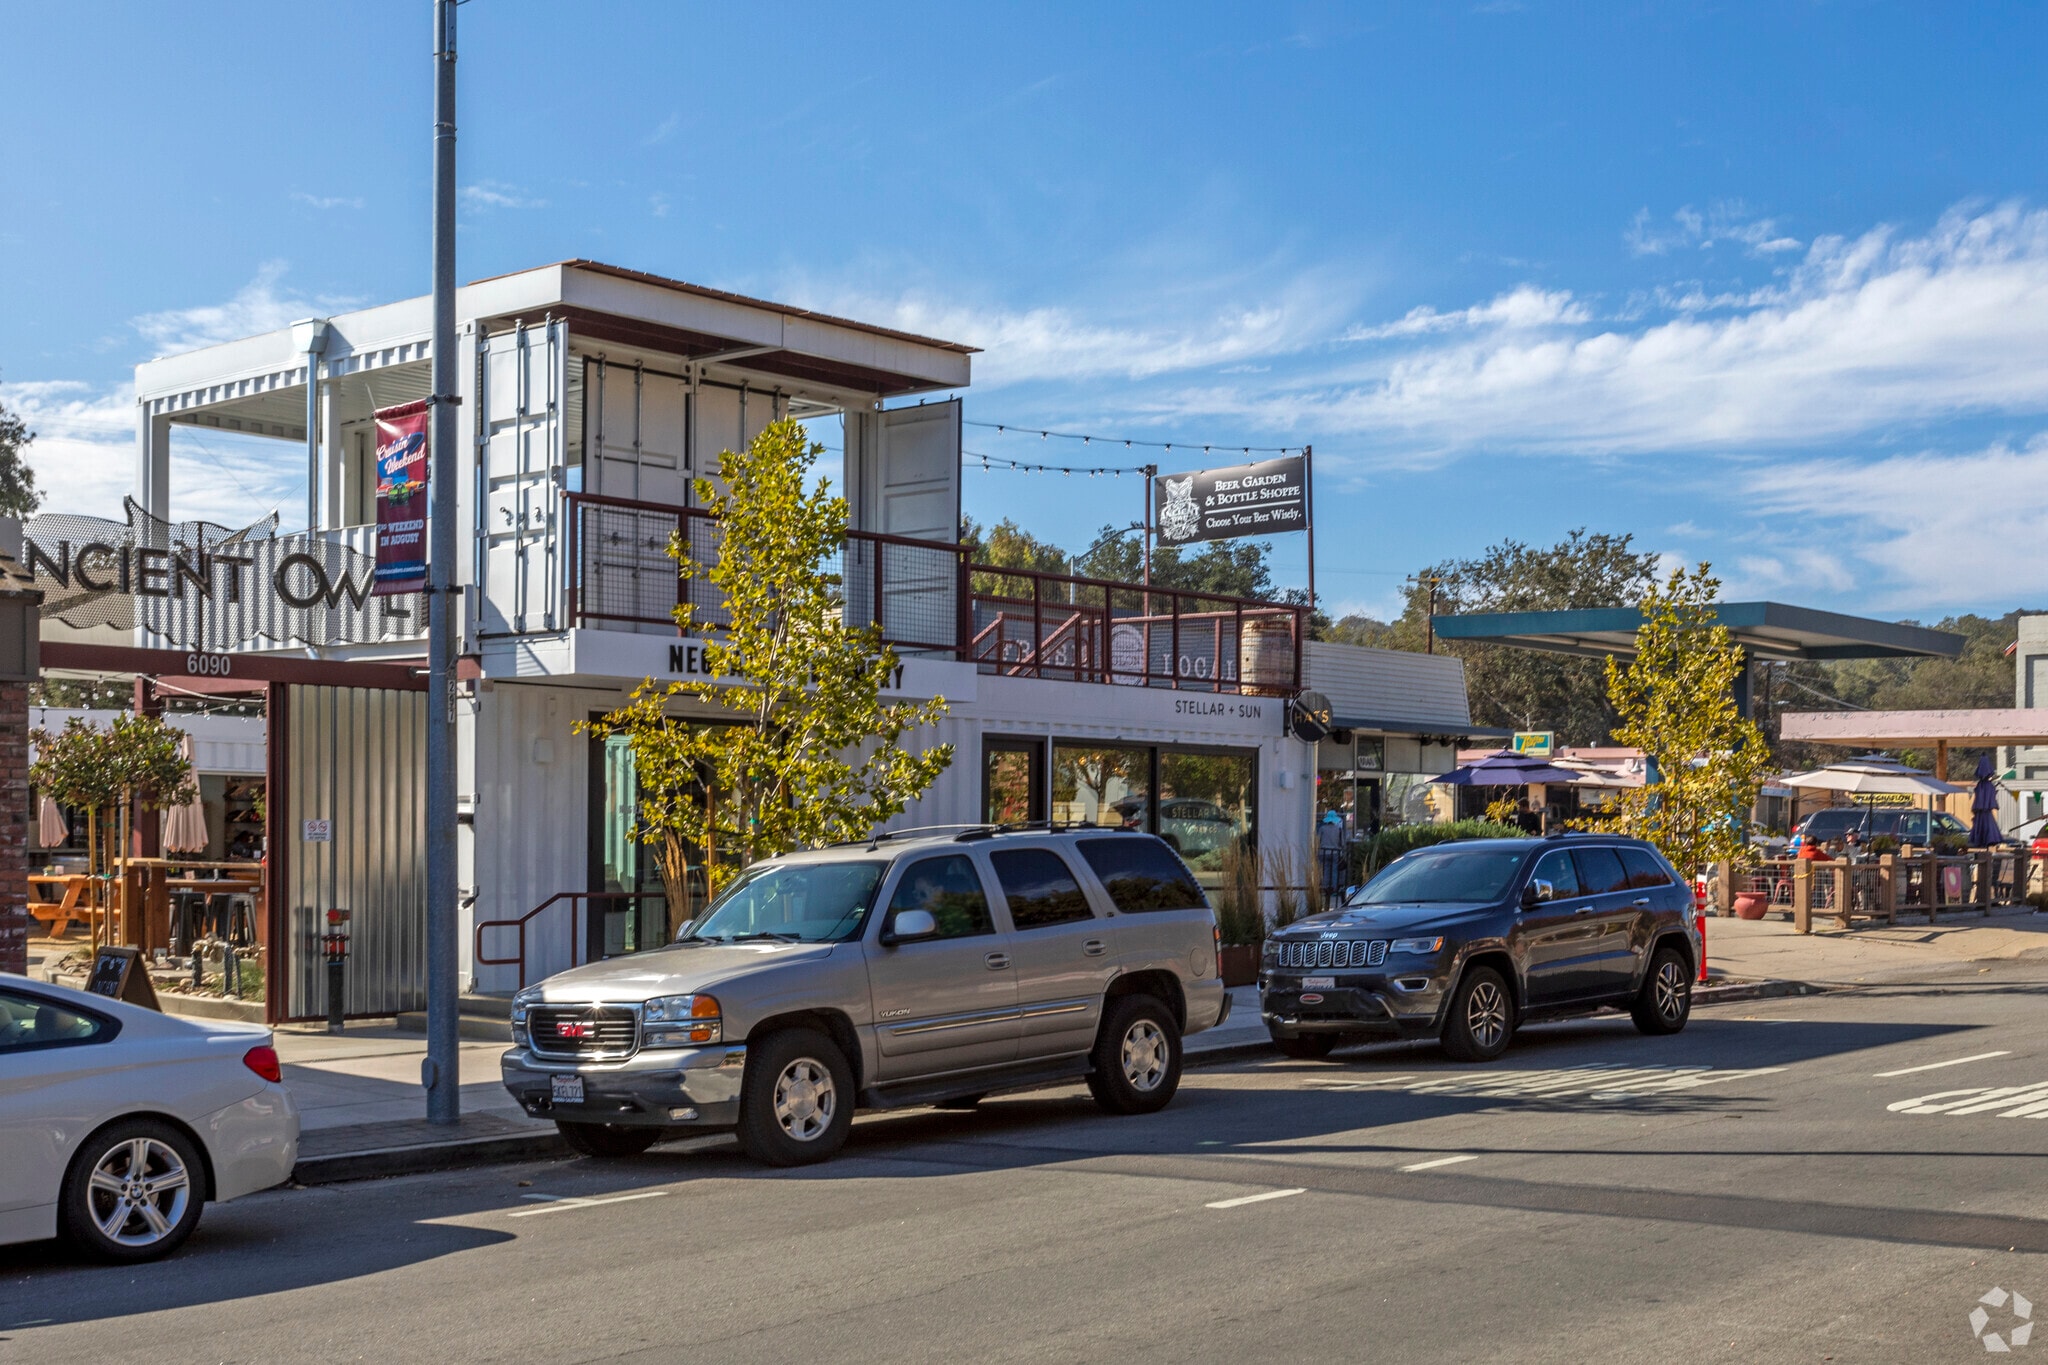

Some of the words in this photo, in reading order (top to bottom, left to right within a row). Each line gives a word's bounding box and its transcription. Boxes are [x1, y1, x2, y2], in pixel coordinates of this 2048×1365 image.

[384, 442, 426, 475] Weekend
[1215, 480, 1240, 492] BEER
[1242, 473, 1287, 488] GARDEN
[1205, 496, 1215, 507] &
[1218, 491, 1258, 506] BOTTLE
[1260, 486, 1300, 499] SHOPPE
[388, 519, 424, 533] WEEKEND
[1206, 517, 1231, 528] Choose
[1232, 513, 1252, 525] Your
[1253, 511, 1270, 522] Beer
[380, 536, 389, 547] IN
[390, 532, 419, 545] AUGUST
[27, 540, 254, 603] NCIENT
[187, 653, 231, 676] 6090
[1175, 700, 1225, 716] STELLAR
[1229, 706, 1235, 715] +
[1238, 705, 1261, 719] SUN
[1294, 709, 1329, 724] HATS
[1320, 931, 1338, 939] Jeep
[880, 1008, 911, 1017] YUKON
[556, 1021, 595, 1038] GMC
